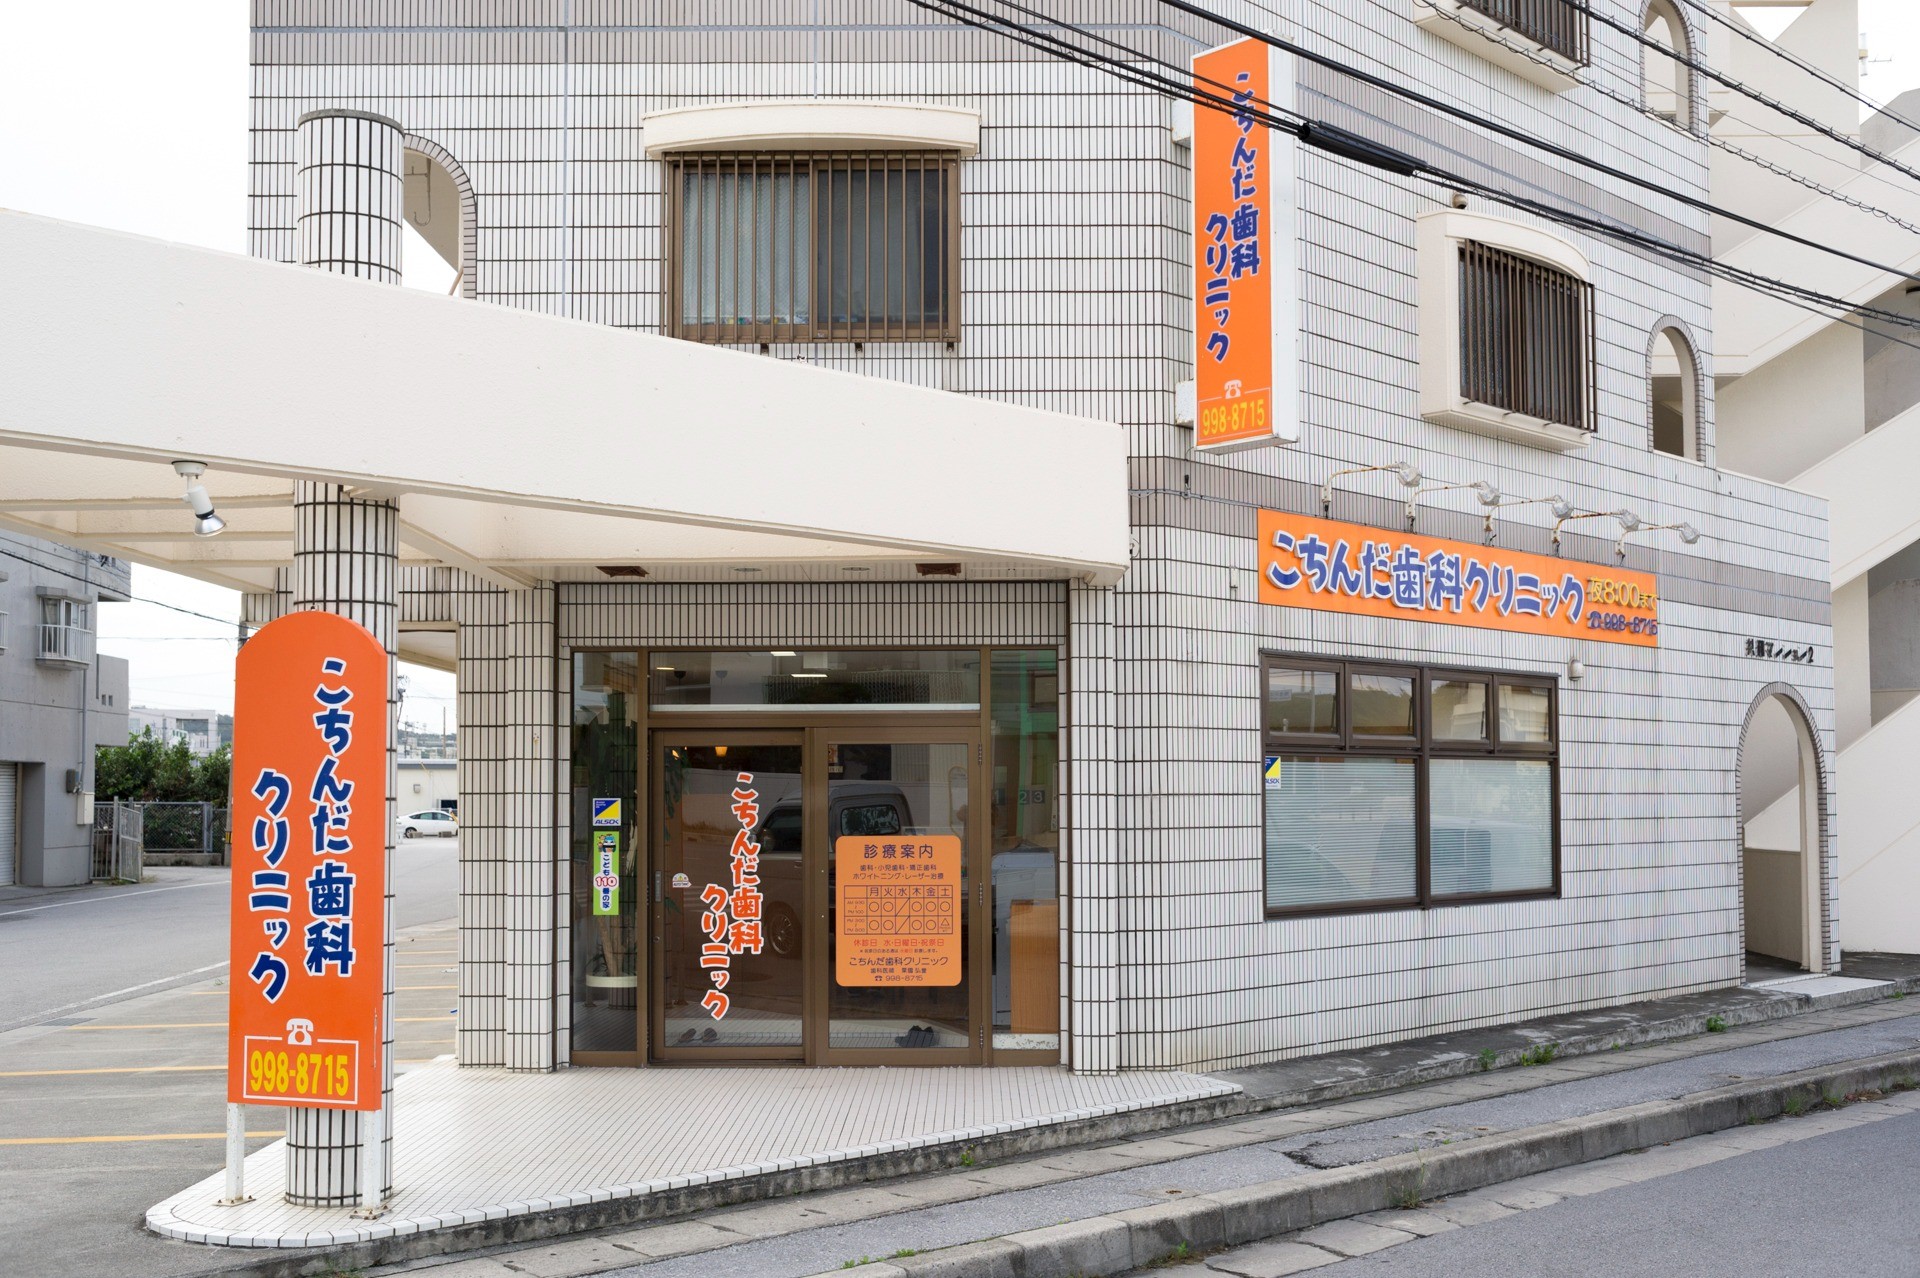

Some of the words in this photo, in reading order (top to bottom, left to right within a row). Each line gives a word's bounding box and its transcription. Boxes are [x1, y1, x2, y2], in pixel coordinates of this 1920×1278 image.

[1205, 212, 1230, 363] クリニック
[1202, 399, 1265, 436] 998-8715
[1266, 530, 1584, 624] こちんだ歯科クリニック
[1603, 613, 1657, 635] 998-8715
[304, 657, 356, 977] こちんだ歯科
[864, 844, 933, 859] 診療案内
[249, 769, 292, 1004] クリニック
[729, 772, 764, 954] こちんだ歯科
[870, 887, 879, 897] 月
[884, 887, 893, 897] 火
[898, 887, 907, 897] 水
[913, 887, 922, 897] 木
[926, 887, 936, 897] 金
[940, 887, 949, 897] 土
[700, 884, 730, 1021] クリニック
[849, 957, 948, 966] こちんだ歯科クリニック
[250, 1049, 350, 1097] 998-8715
